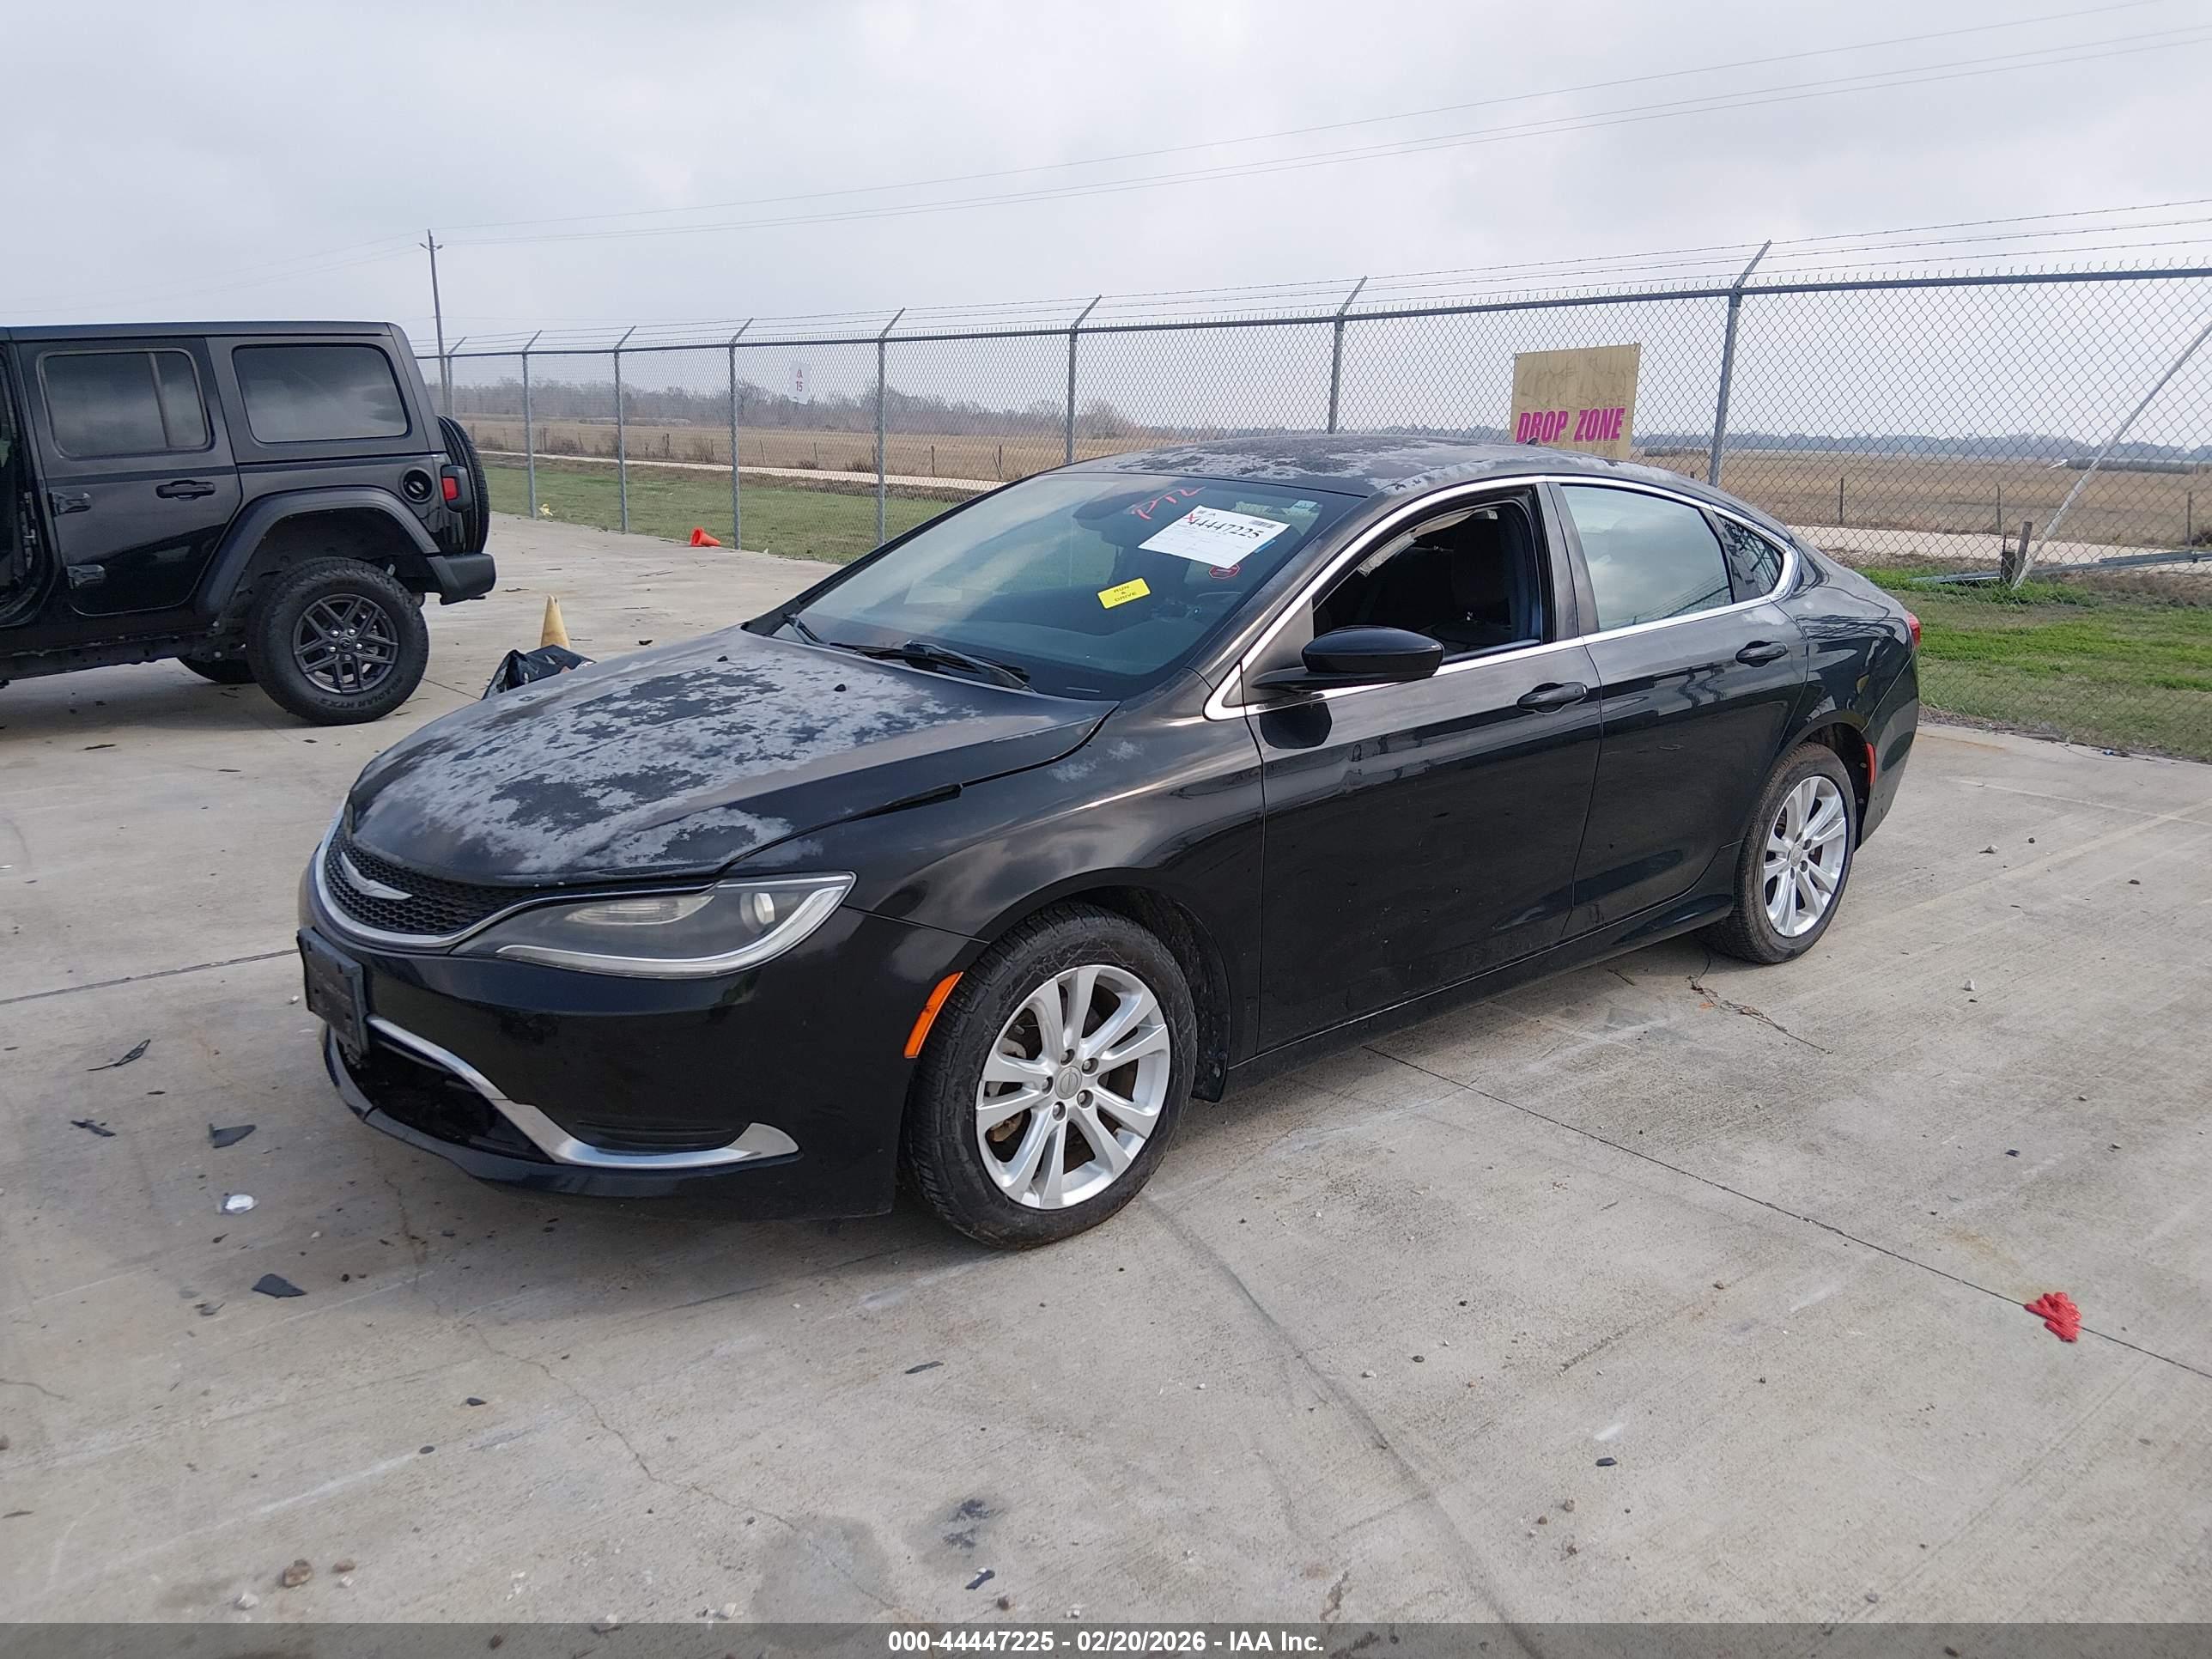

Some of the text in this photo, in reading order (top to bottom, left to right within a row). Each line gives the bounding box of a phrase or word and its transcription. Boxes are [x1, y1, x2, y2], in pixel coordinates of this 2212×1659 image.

[795, 380, 804, 392] 15
[1516, 408, 1625, 443] DROP ZONE
[1115, 592, 1138, 602] DRIVE
